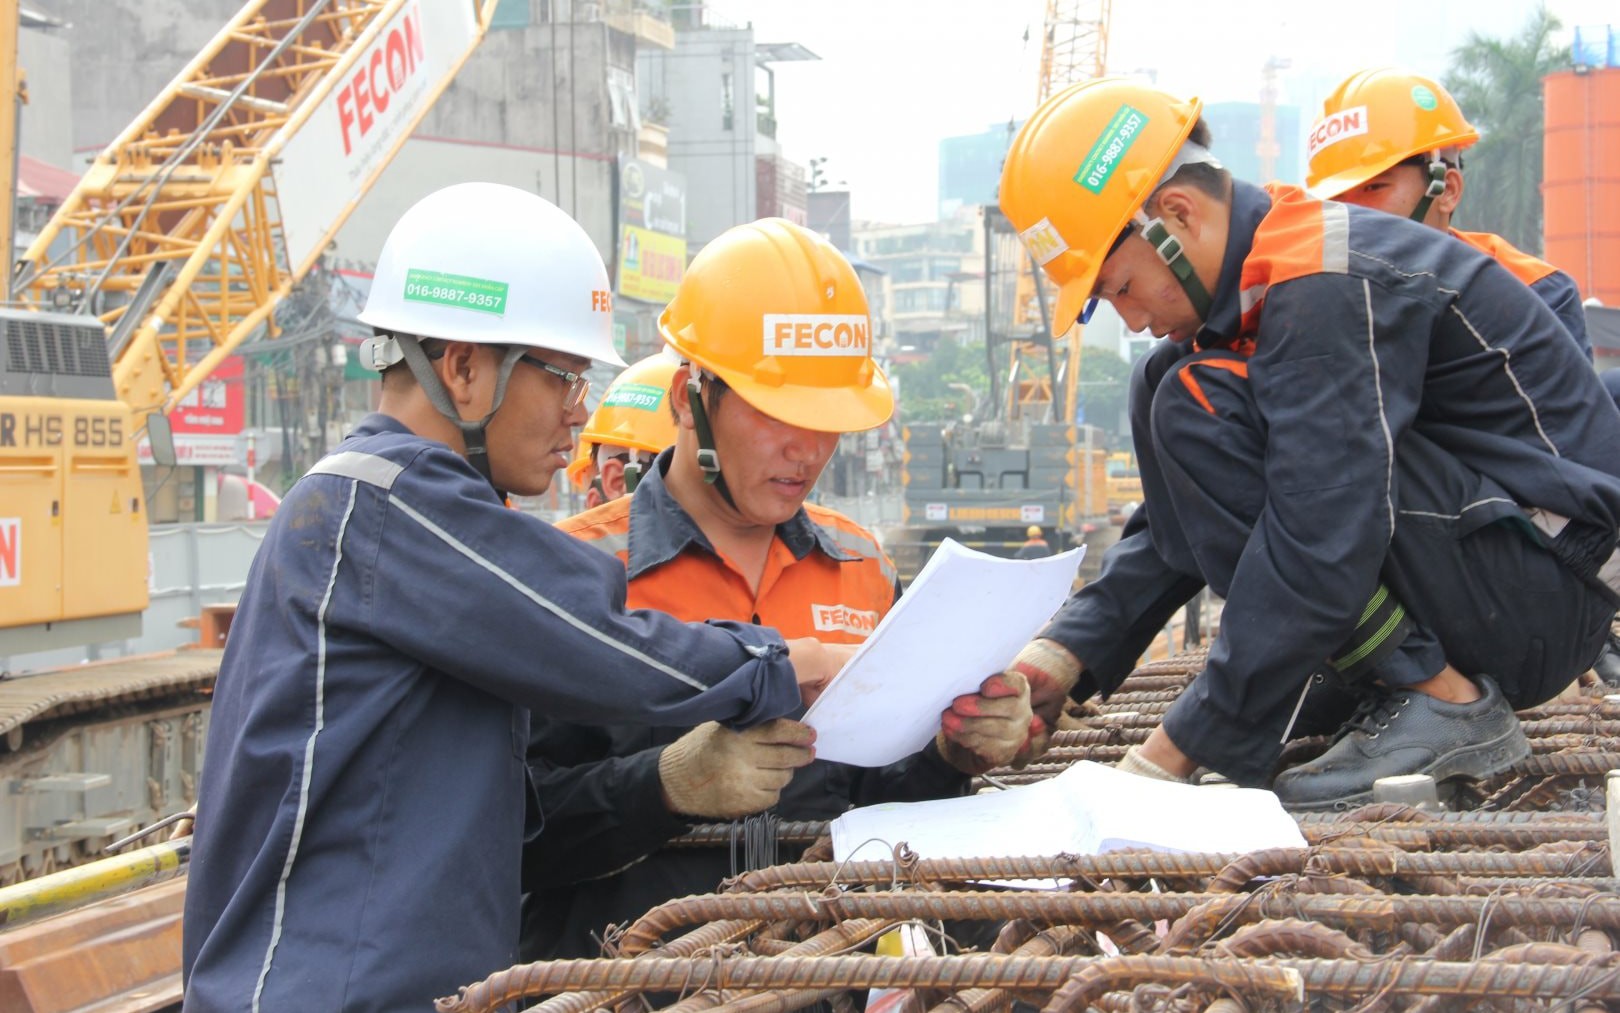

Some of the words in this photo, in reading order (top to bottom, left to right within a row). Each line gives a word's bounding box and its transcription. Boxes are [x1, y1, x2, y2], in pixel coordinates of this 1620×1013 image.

[336, 4, 424, 157] FECON
[1087, 113, 1142, 187] 016-9887-9357
[407, 283, 502, 308] 016-9887-9357
[775, 323, 866, 349] FECON
[25, 414, 62, 446] HS
[74, 417, 122, 446] 855
[820, 608, 877, 631] FECON
